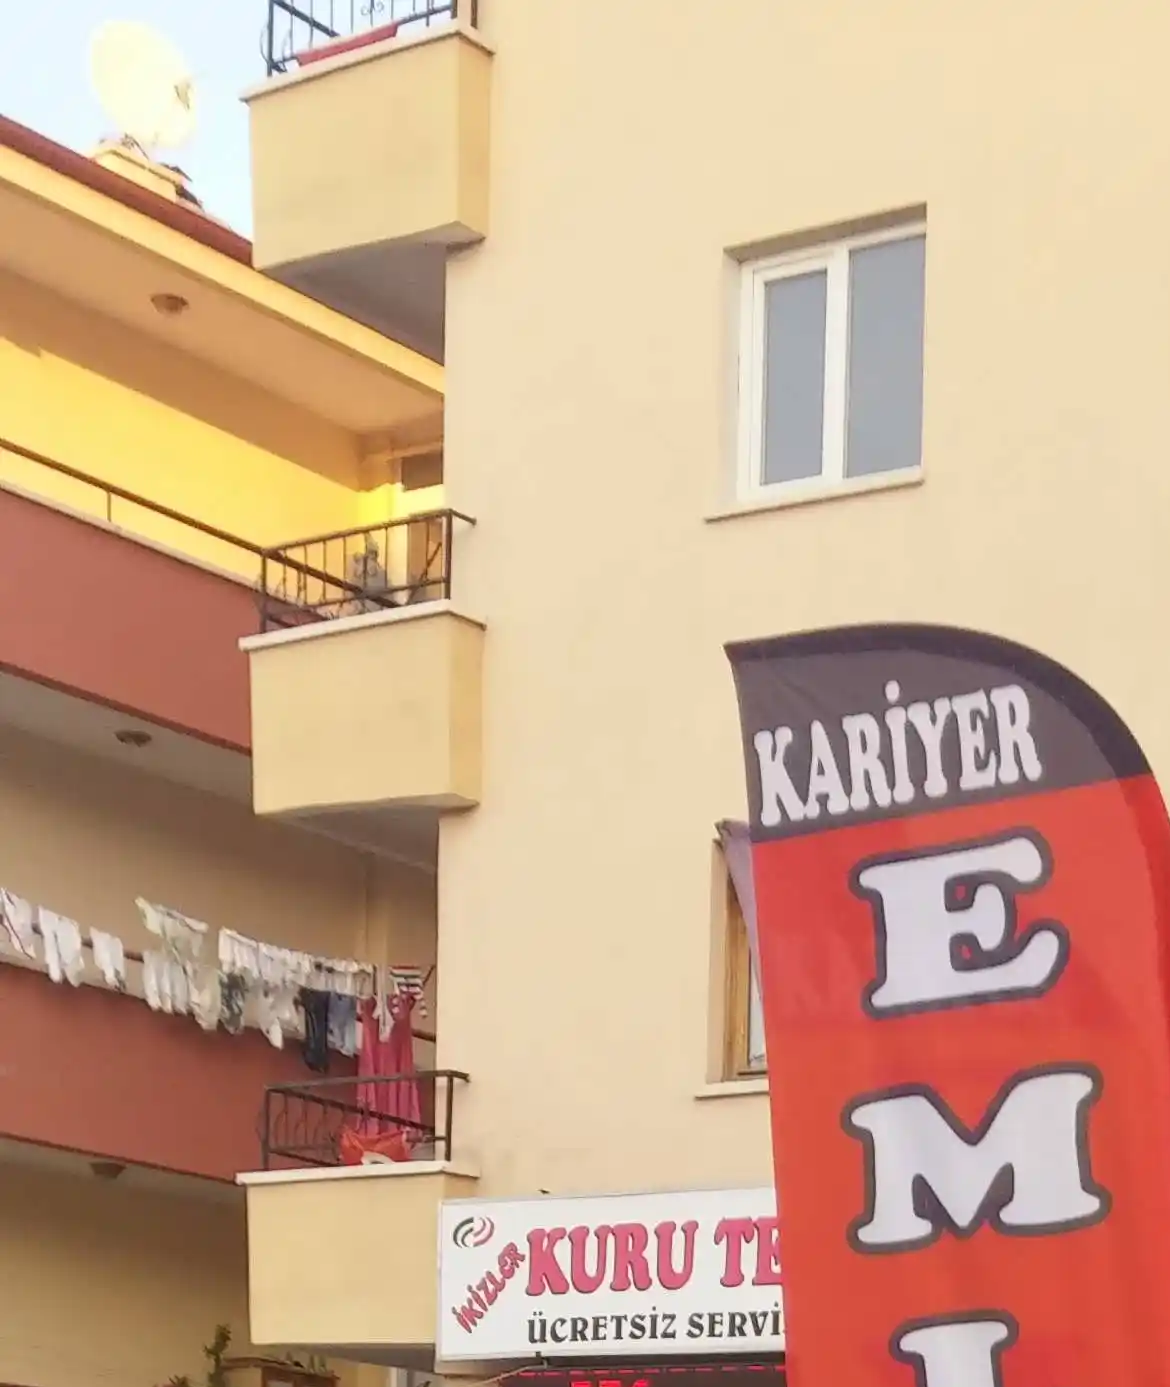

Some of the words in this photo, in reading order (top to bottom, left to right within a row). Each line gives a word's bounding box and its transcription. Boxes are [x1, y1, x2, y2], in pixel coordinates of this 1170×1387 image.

[753, 679, 1043, 828] KARİYER
[451, 1241, 526, 1334] İKİZLER
[524, 1219, 700, 1297] KURU
[527, 1306, 678, 1345] ÜCRETSİZ
[685, 1301, 786, 1339] SERVİ
